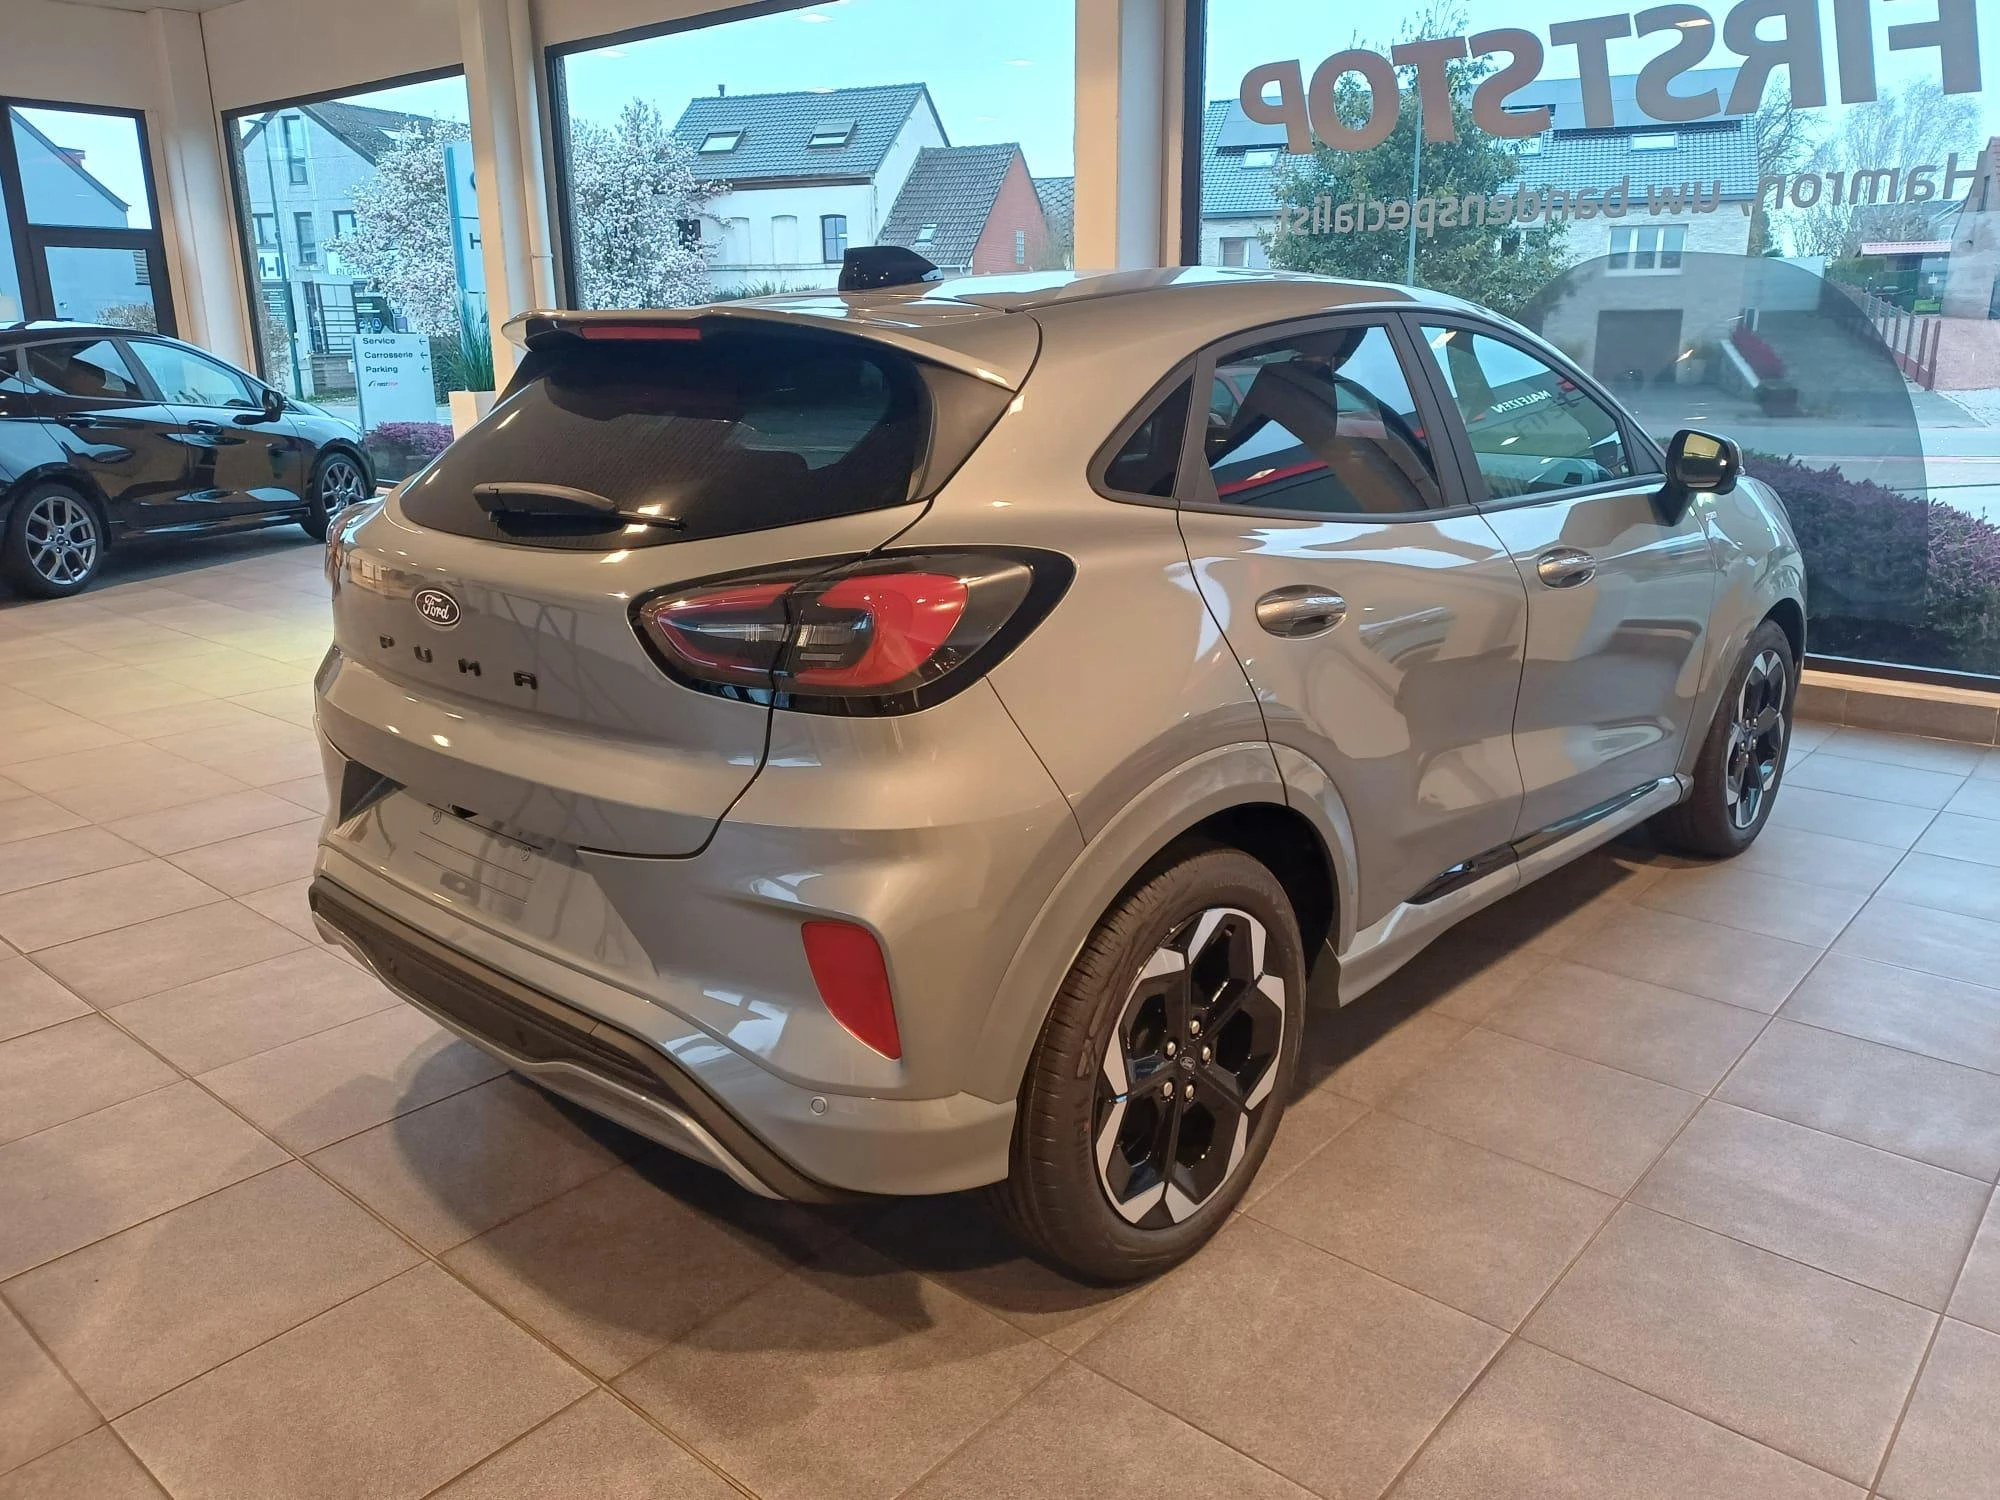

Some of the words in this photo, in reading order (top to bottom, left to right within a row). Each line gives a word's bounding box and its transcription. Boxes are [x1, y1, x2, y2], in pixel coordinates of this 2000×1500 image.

[362, 337, 396, 345] Service
[364, 351, 414, 359] Carrosserie
[365, 366, 399, 374] Parking
[422, 594, 451, 621] Ford
[379, 634, 539, 690] PUMA
